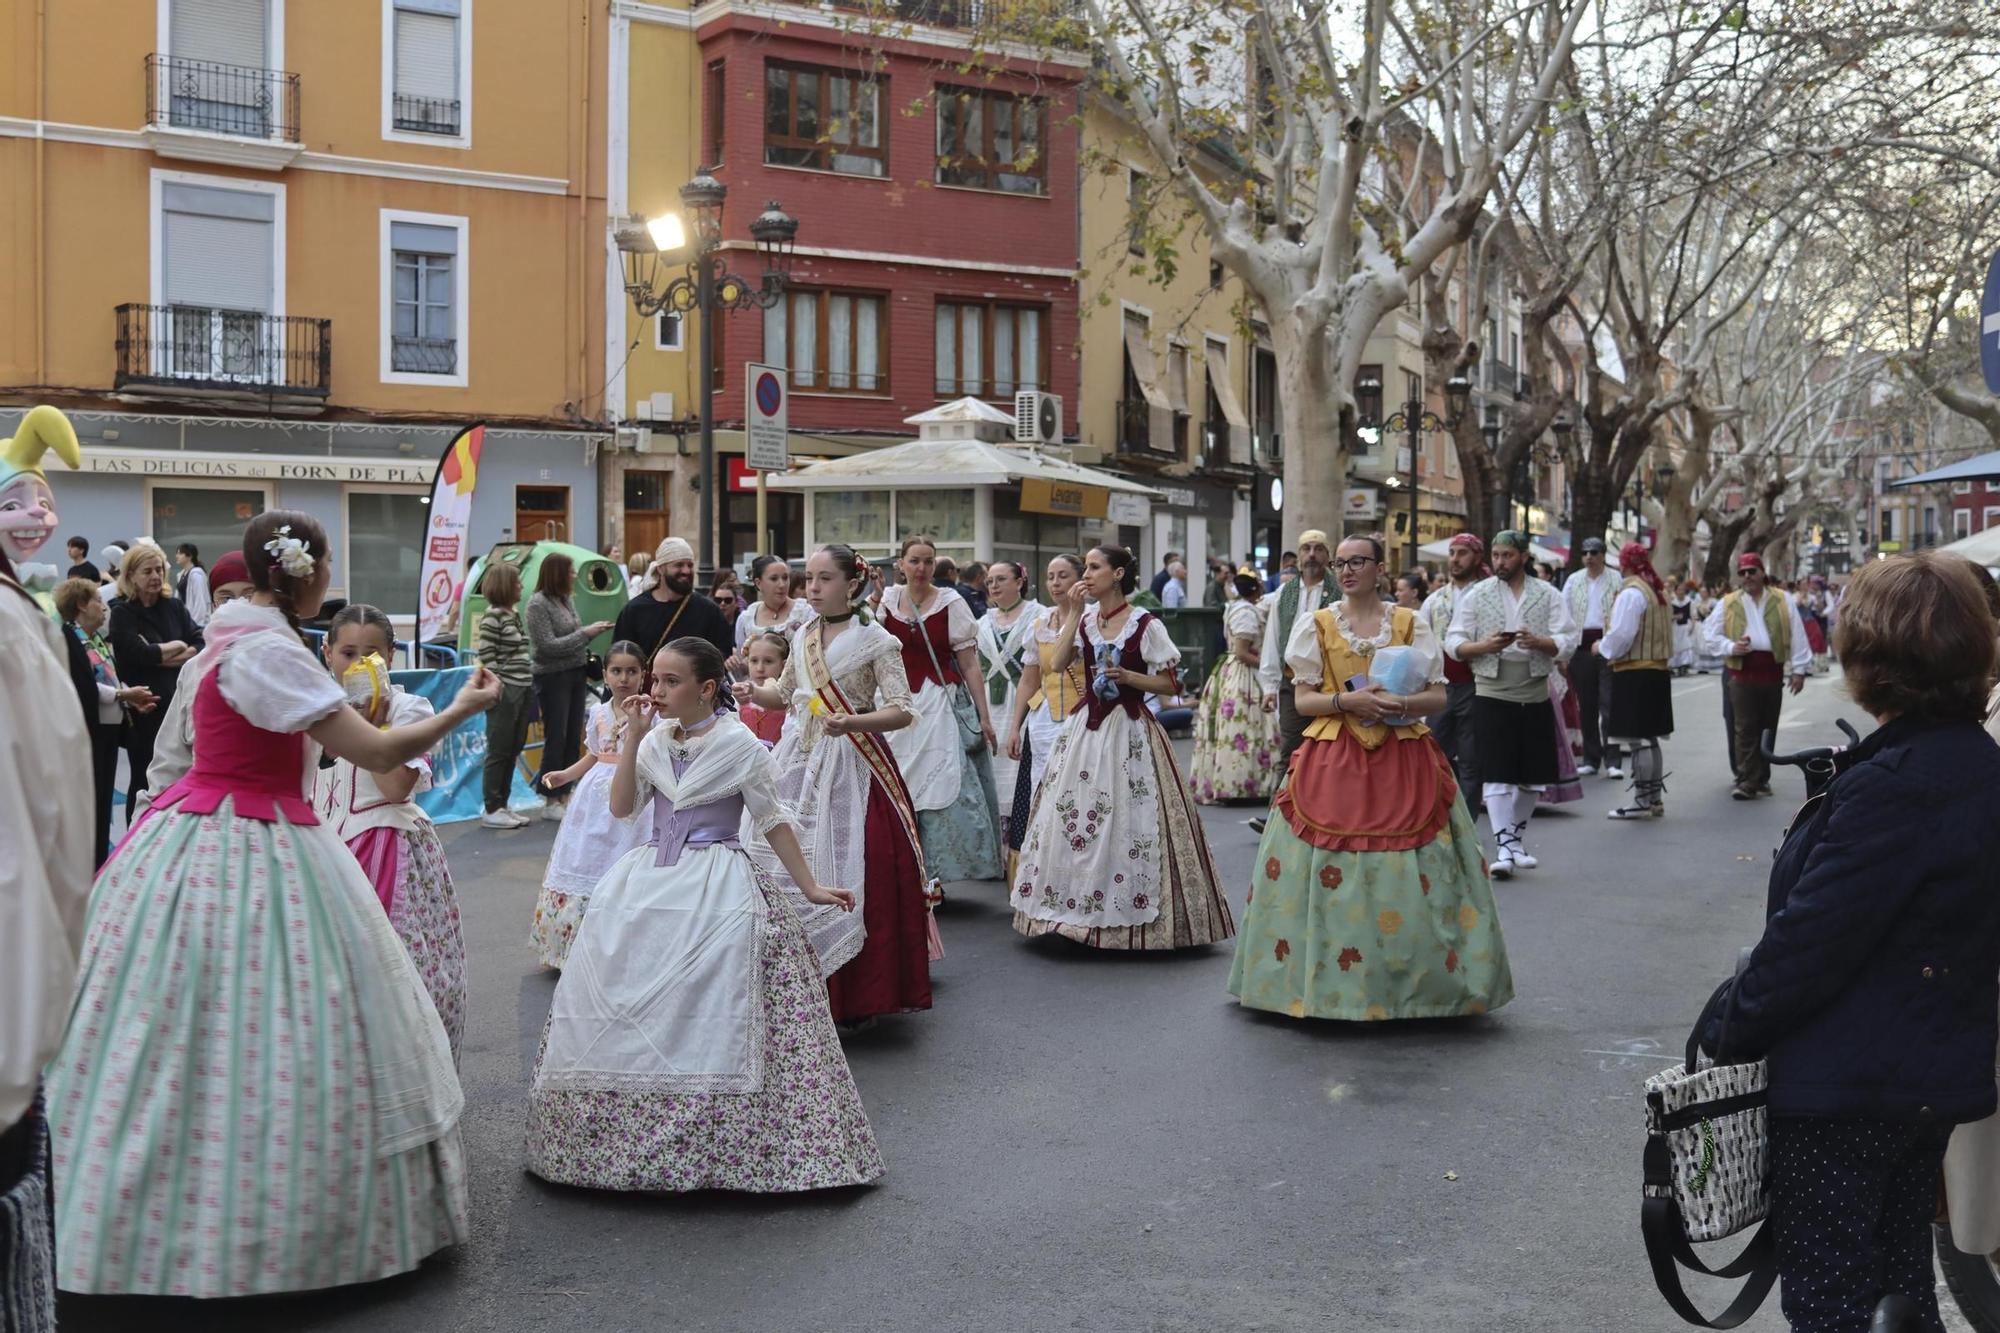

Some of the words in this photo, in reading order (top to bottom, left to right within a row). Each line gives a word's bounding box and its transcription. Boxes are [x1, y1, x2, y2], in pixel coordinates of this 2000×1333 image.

[92, 459, 132, 472] LAS
[144, 460, 237, 475] DELICIAS
[248, 467, 266, 477] del
[280, 465, 337, 478] FORN
[350, 467, 376, 480] DE
[1051, 484, 1083, 505] Levante
